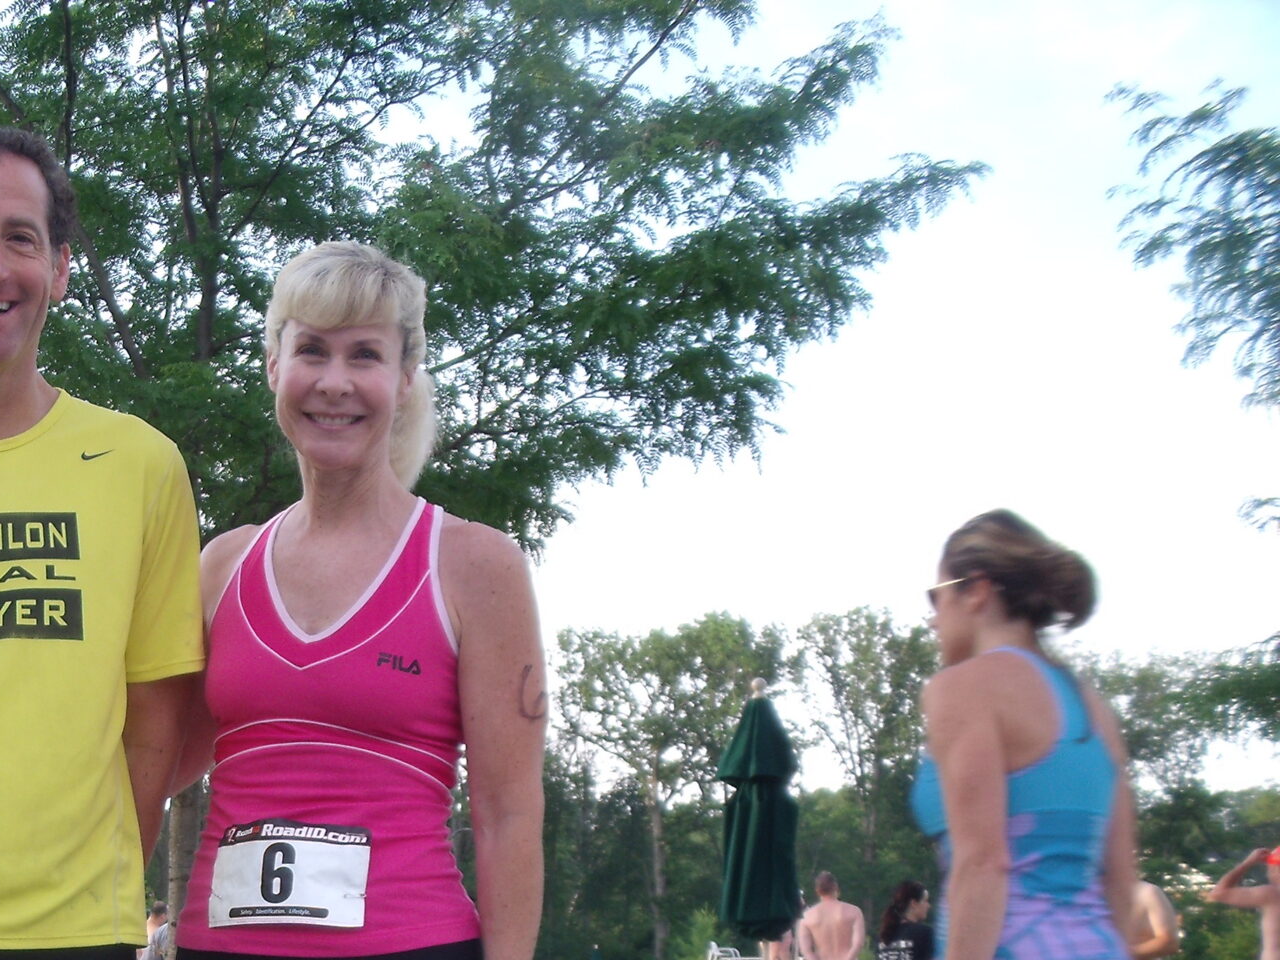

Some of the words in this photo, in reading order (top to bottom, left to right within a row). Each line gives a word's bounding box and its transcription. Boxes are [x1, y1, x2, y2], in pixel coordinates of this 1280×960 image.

[376, 652, 422, 676] FILA
[261, 823, 368, 844] RoadID.com
[261, 842, 296, 904] 6
